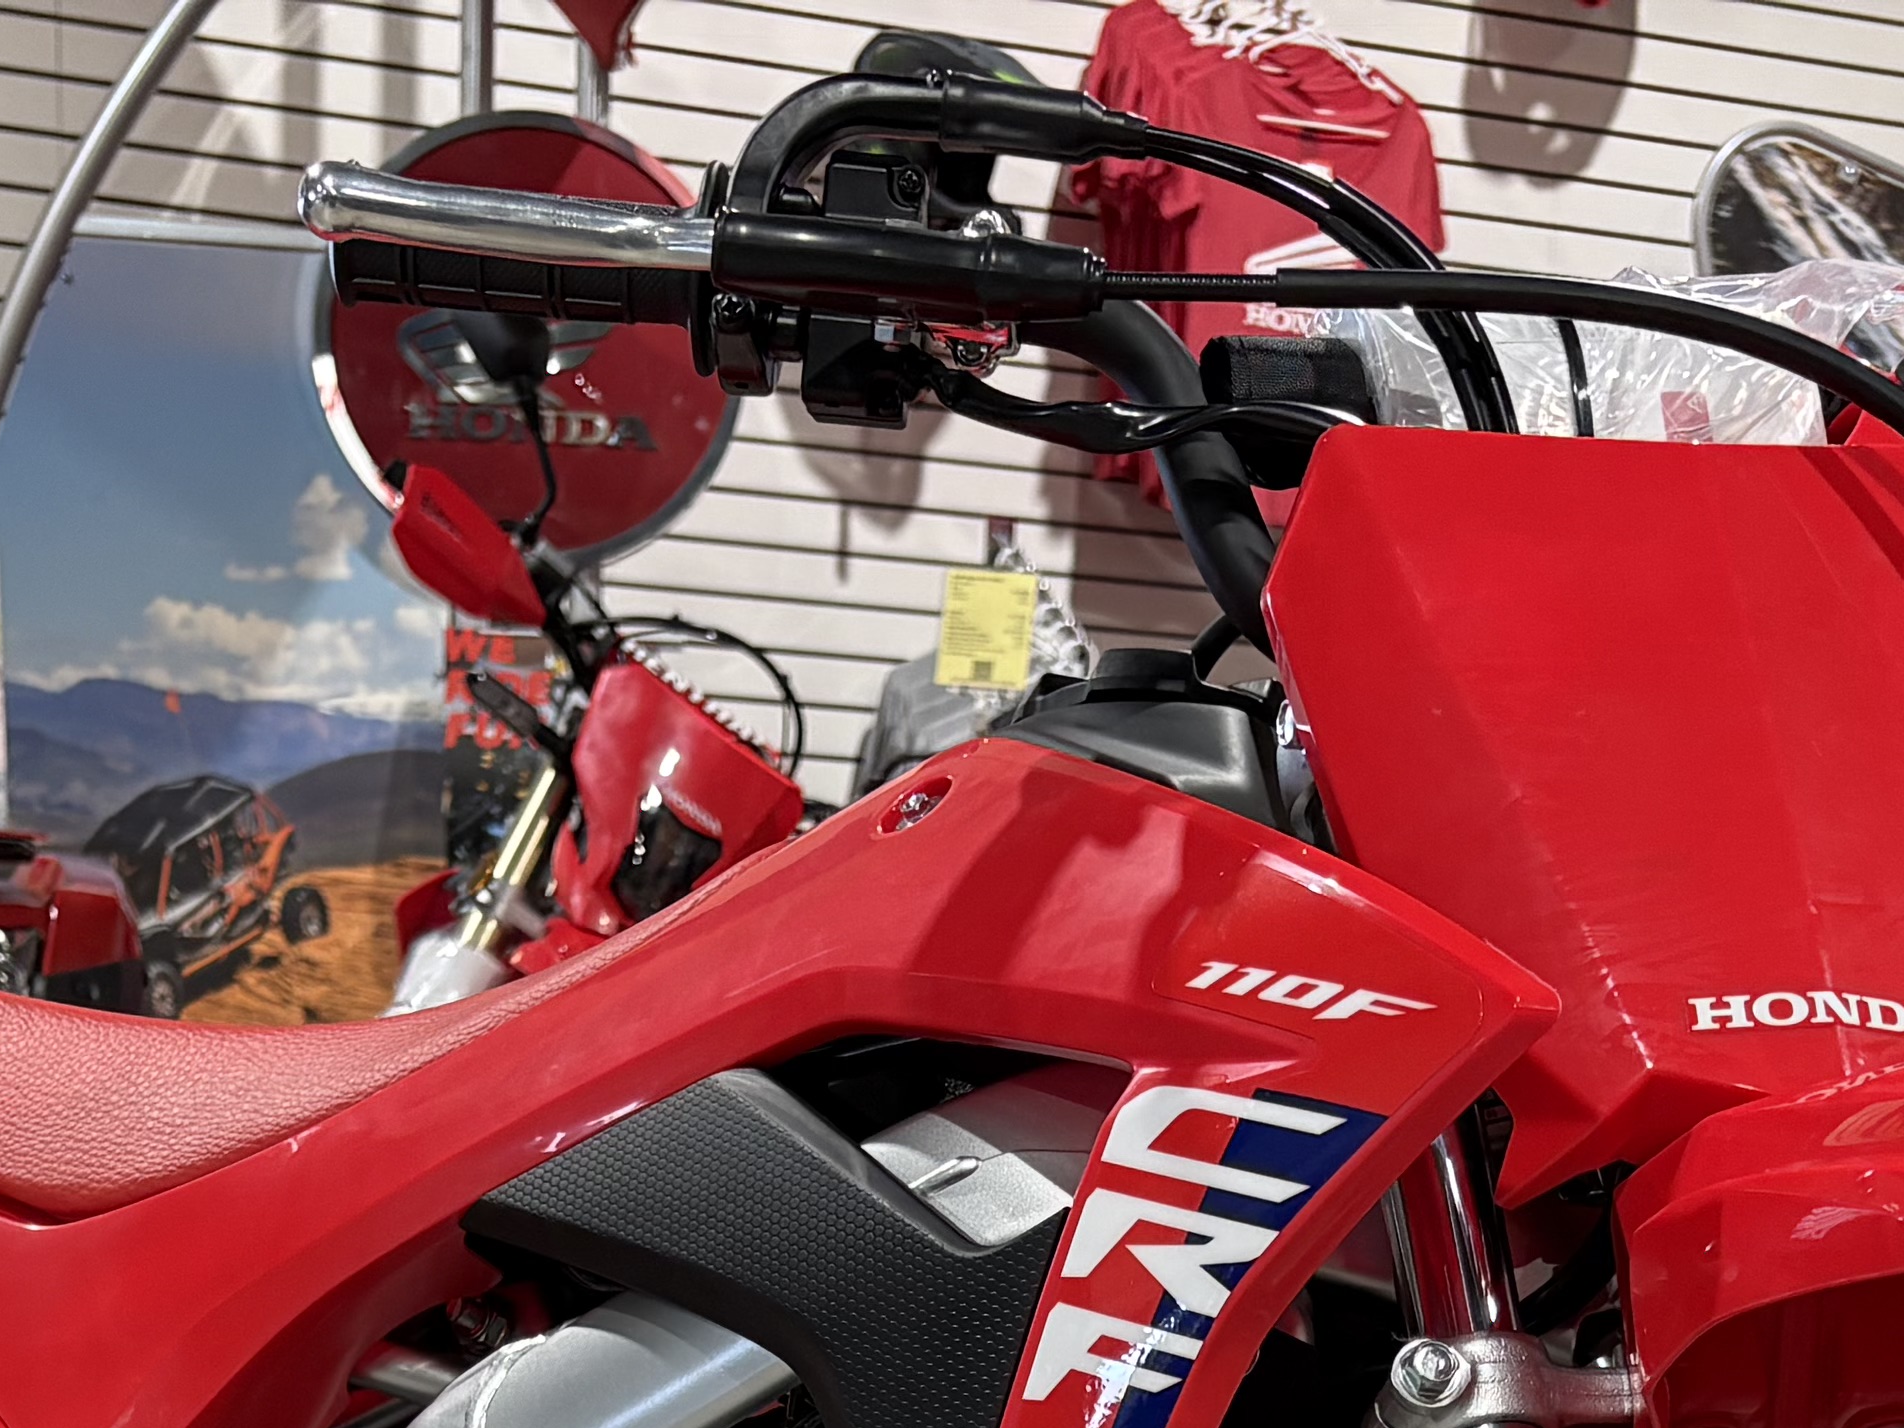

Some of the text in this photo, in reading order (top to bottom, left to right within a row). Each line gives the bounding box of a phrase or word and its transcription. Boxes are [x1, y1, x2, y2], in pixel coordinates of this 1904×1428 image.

[446, 627, 516, 664] WE
[446, 669, 554, 707] RDE
[1184, 960, 1439, 1021] 110F
[1021, 1085, 1348, 1402] CRF
